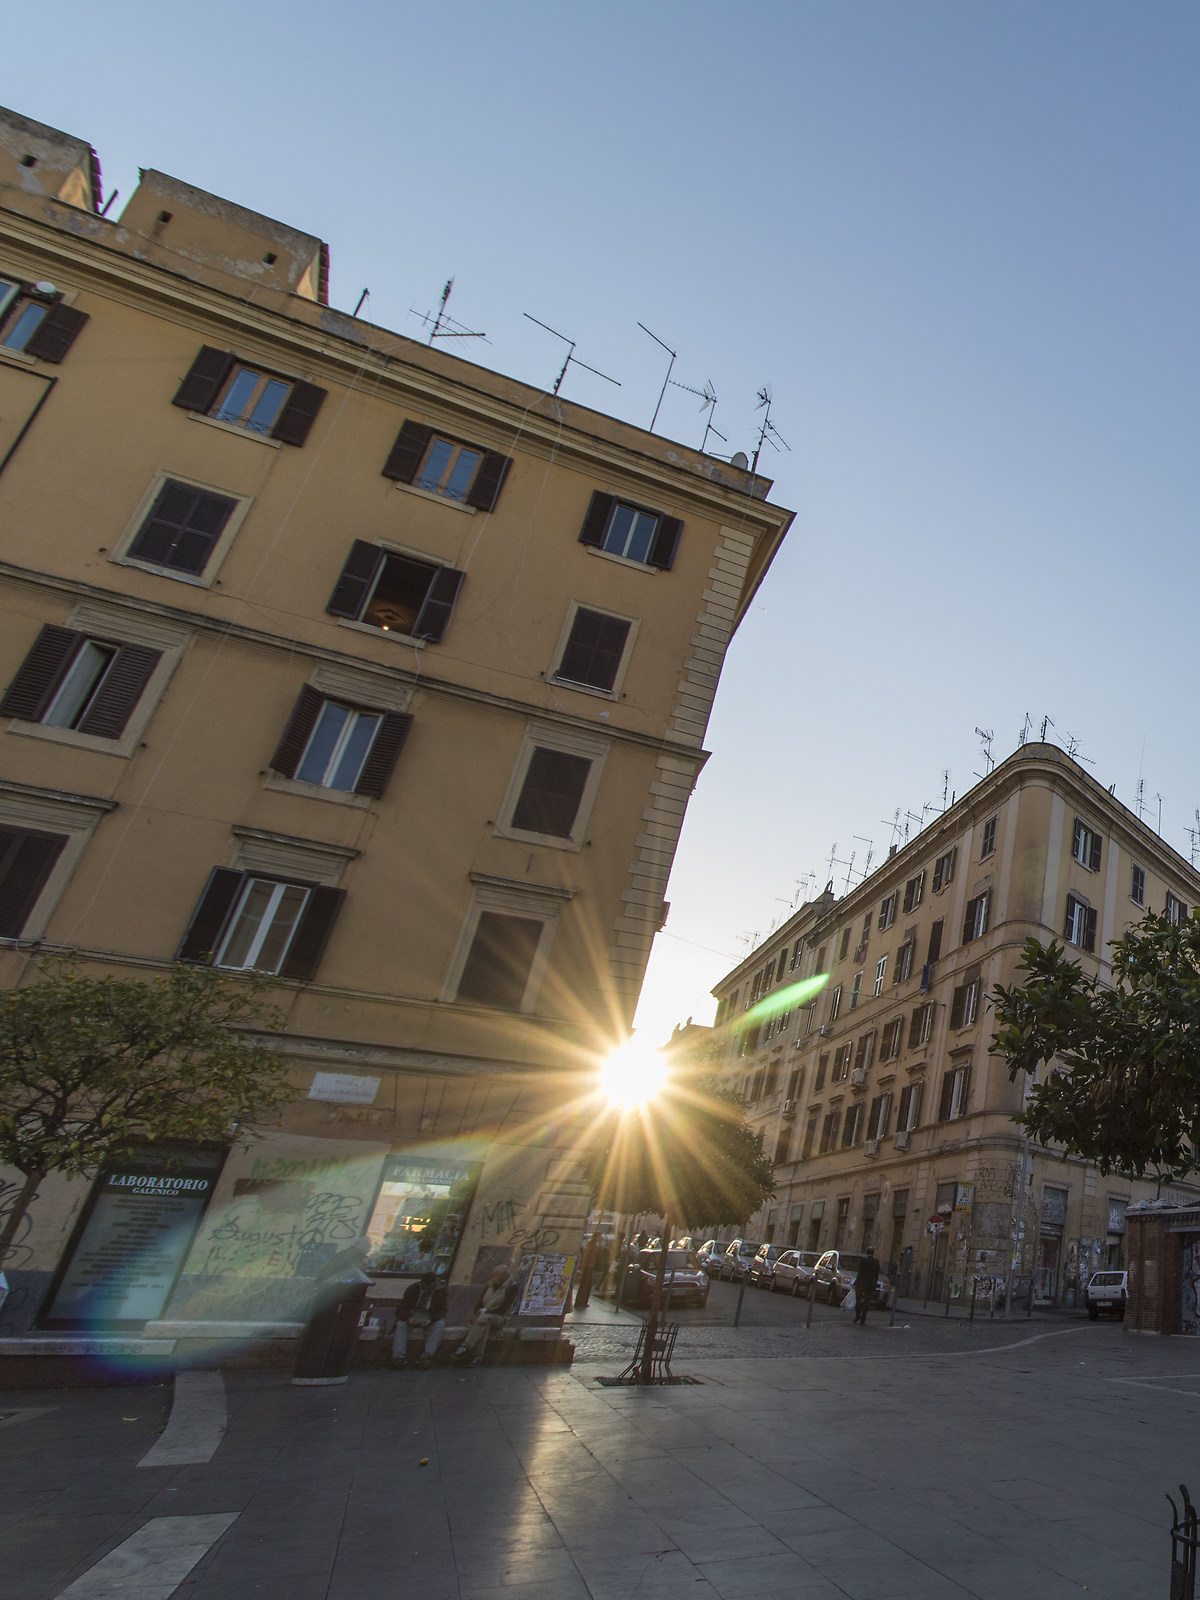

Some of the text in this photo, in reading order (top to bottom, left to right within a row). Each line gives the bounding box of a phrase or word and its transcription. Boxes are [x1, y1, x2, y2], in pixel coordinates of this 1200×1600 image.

[392, 1167, 469, 1181] FARMACIA
[108, 1174, 209, 1191] LABORATORIO
[132, 1187, 179, 1197] GALENICO
